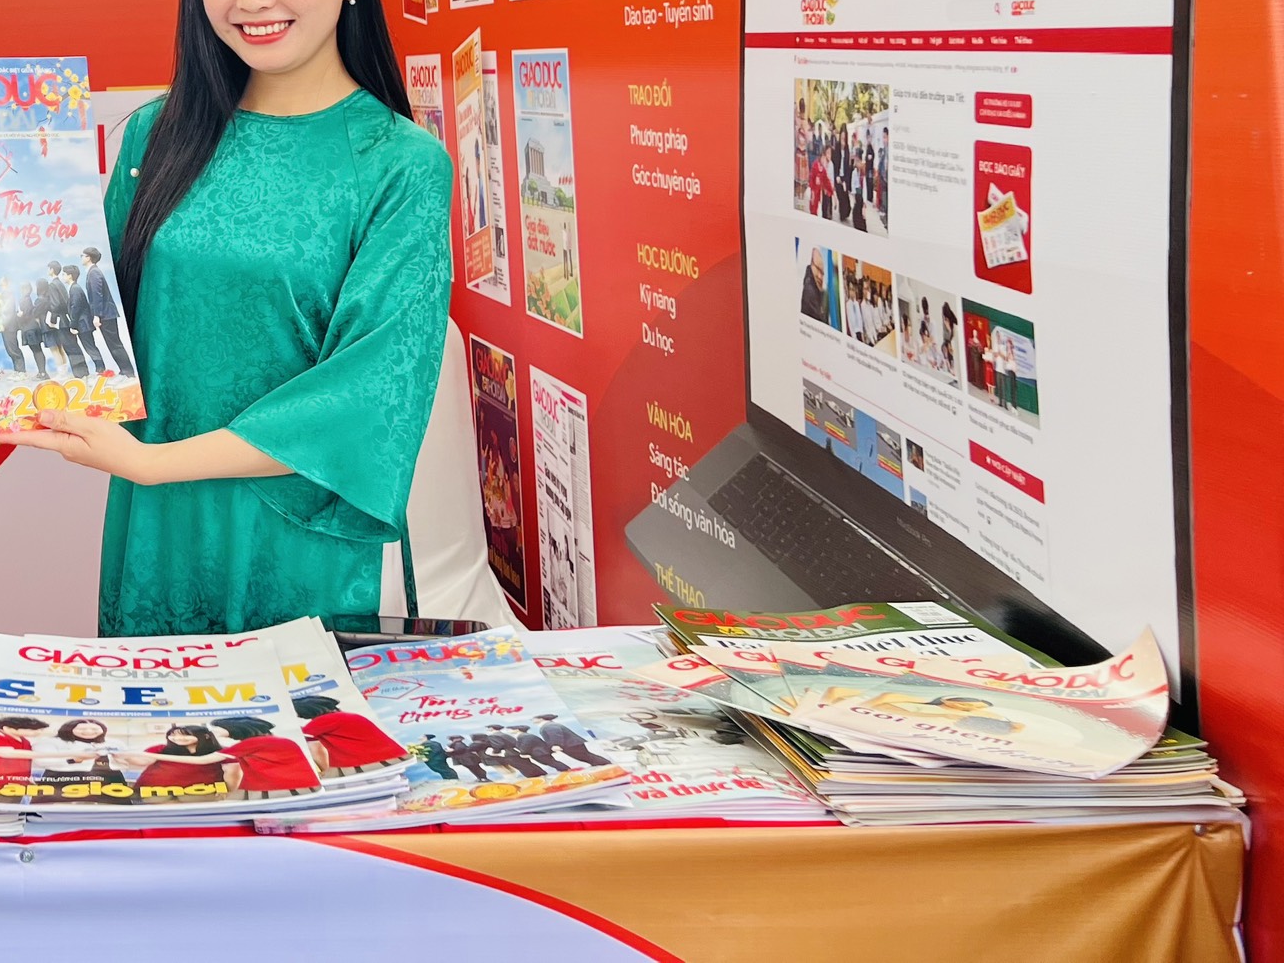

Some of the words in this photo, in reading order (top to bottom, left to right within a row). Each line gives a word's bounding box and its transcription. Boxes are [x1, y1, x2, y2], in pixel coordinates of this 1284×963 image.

[628, 84, 653, 106] TRAO
[637, 243, 659, 270] HỌC
[660, 247, 699, 279] ĐƯỜNG
[642, 322, 655, 347] Du
[655, 326, 675, 357] học
[669, 412, 694, 444] HÓA
[651, 482, 668, 511] Đời
[668, 493, 694, 530] sống
[714, 519, 736, 550] hóa
[674, 609, 788, 630] GIÁO
[789, 605, 885, 629] DỤC
[18, 645, 128, 669] GIÁO
[133, 655, 219, 670] DỤC
[966, 668, 1065, 688] GIÁO
